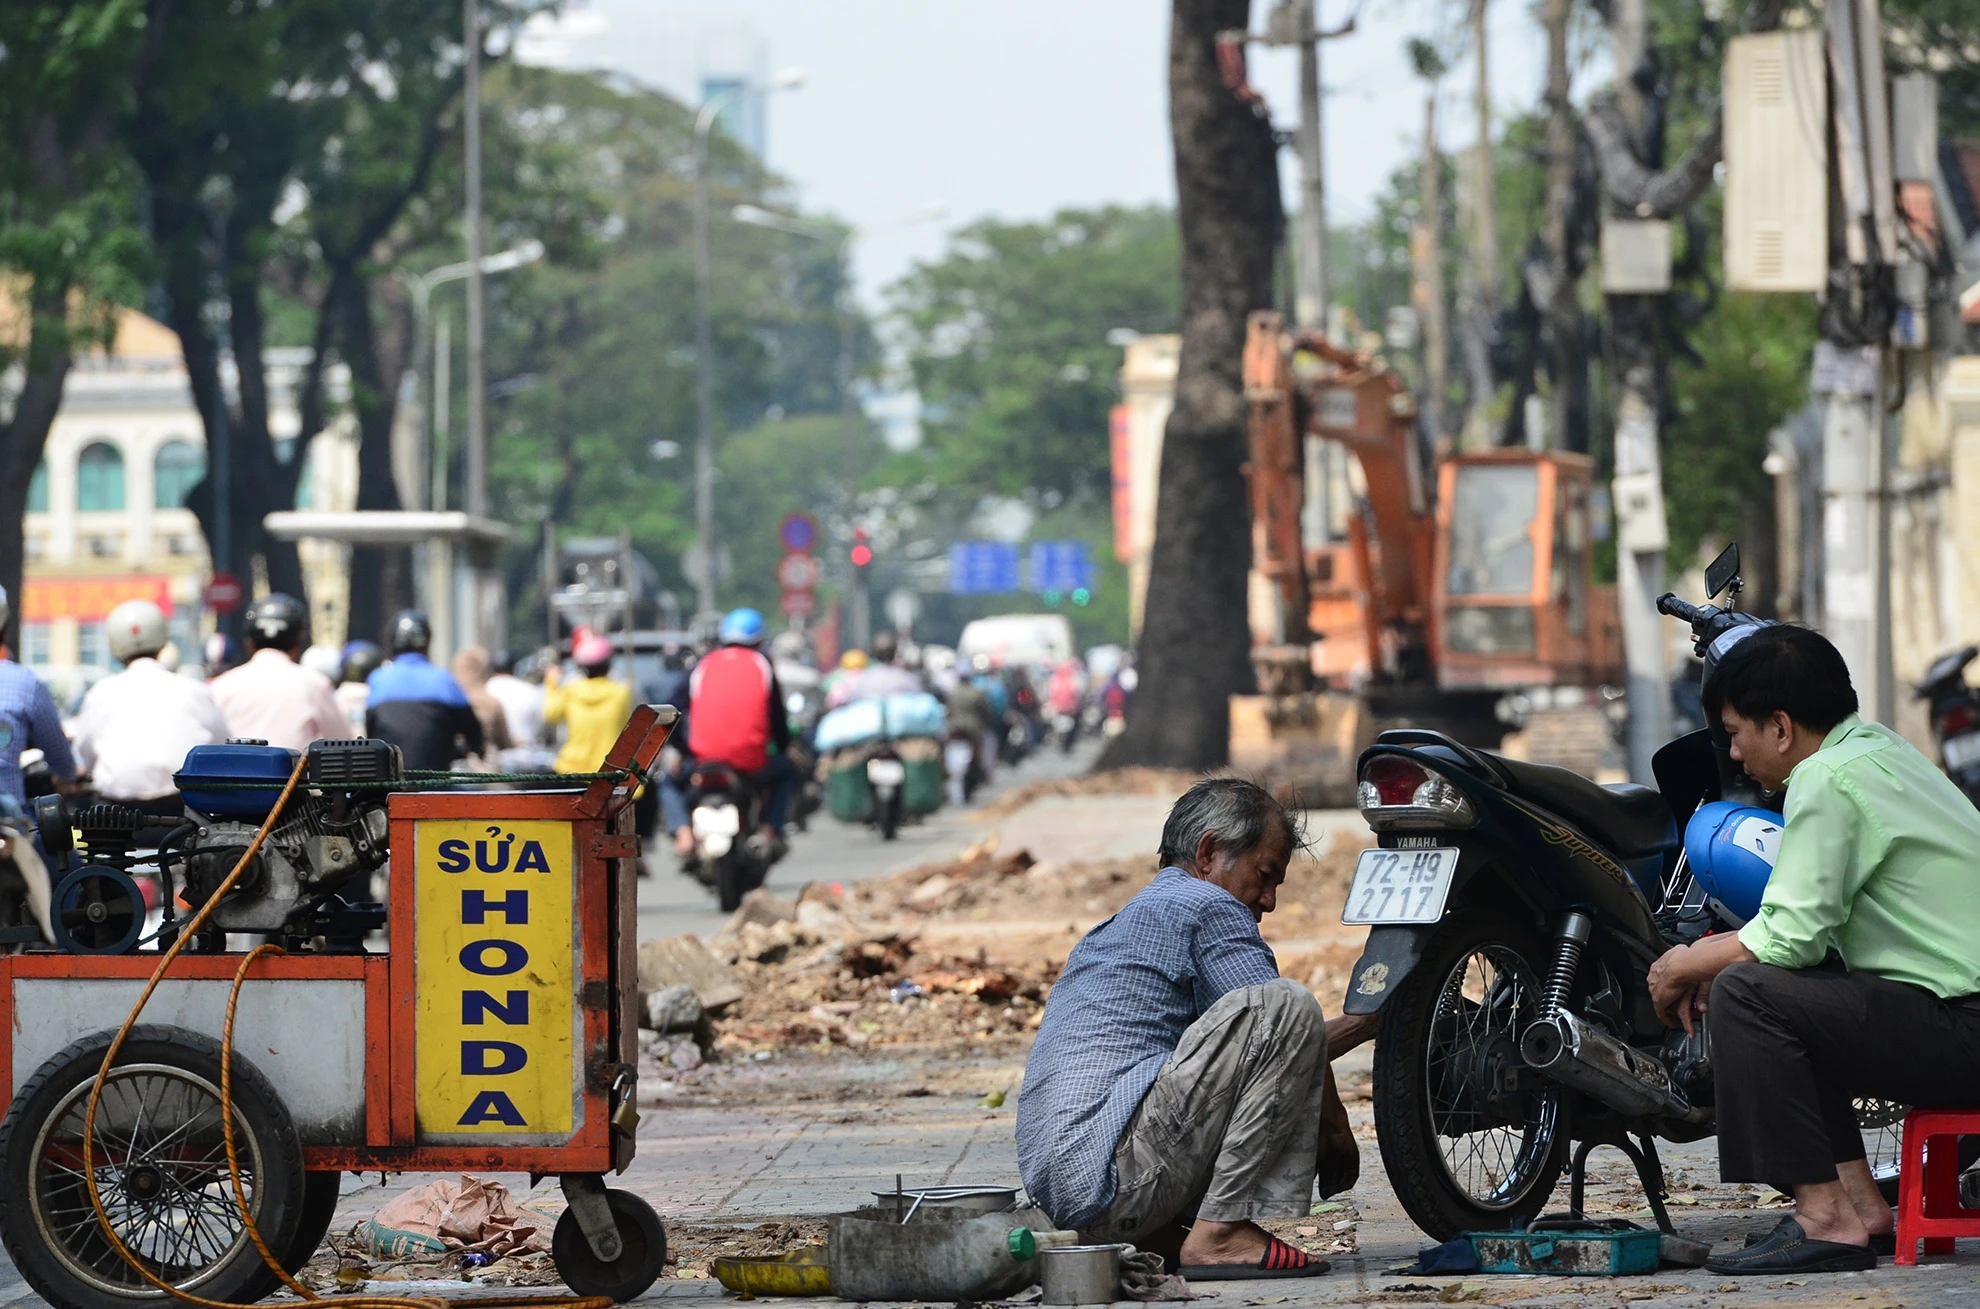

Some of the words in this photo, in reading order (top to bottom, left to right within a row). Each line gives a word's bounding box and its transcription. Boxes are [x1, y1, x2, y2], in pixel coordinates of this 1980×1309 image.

[437, 826, 551, 873] SỬA
[1397, 837, 1438, 848] YAMAHA
[1366, 852, 1443, 885] 72-H9
[1356, 886, 1434, 919] 2717
[456, 889, 529, 1126] HONDA
